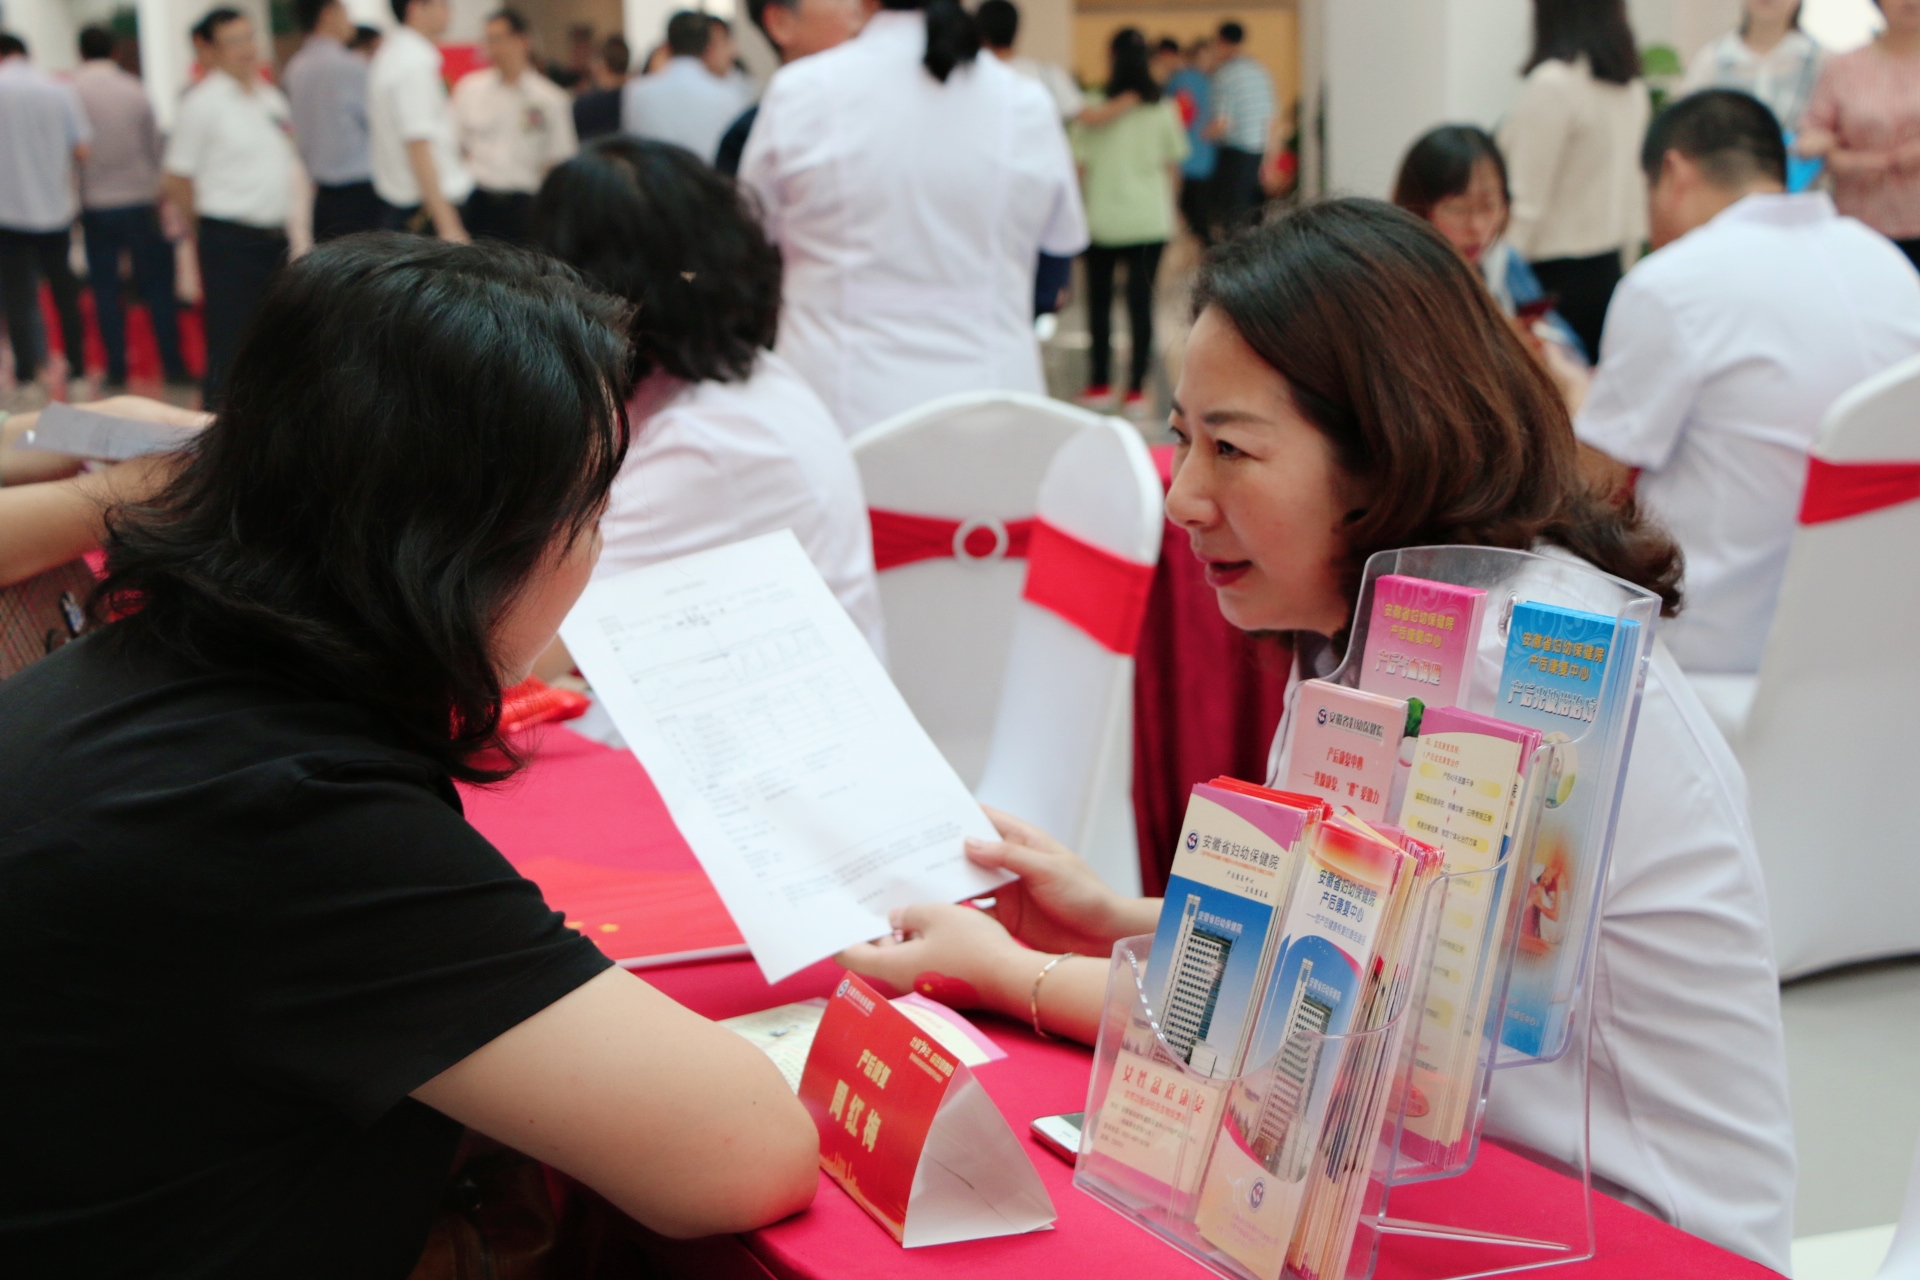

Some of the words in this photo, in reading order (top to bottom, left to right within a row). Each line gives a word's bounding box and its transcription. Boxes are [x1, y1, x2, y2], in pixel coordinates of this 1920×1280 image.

[1522, 632, 1605, 663] 安徽省妇幼保健院
[1528, 654, 1590, 681] 产后康复中心
[1328, 711, 1384, 738] 安徽省妇幼保健院
[1326, 746, 1364, 771] 产后康复中心
[1202, 834, 1280, 870] 安徽省妇幼保健院
[1318, 869, 1377, 907] 安徽省妇幼保健院
[1319, 891, 1364, 923] 产后康复中心
[856, 1049, 892, 1090] 产后康复
[1122, 1064, 1205, 1113] 女性盆底康复
[828, 1079, 882, 1153] 周红梅
